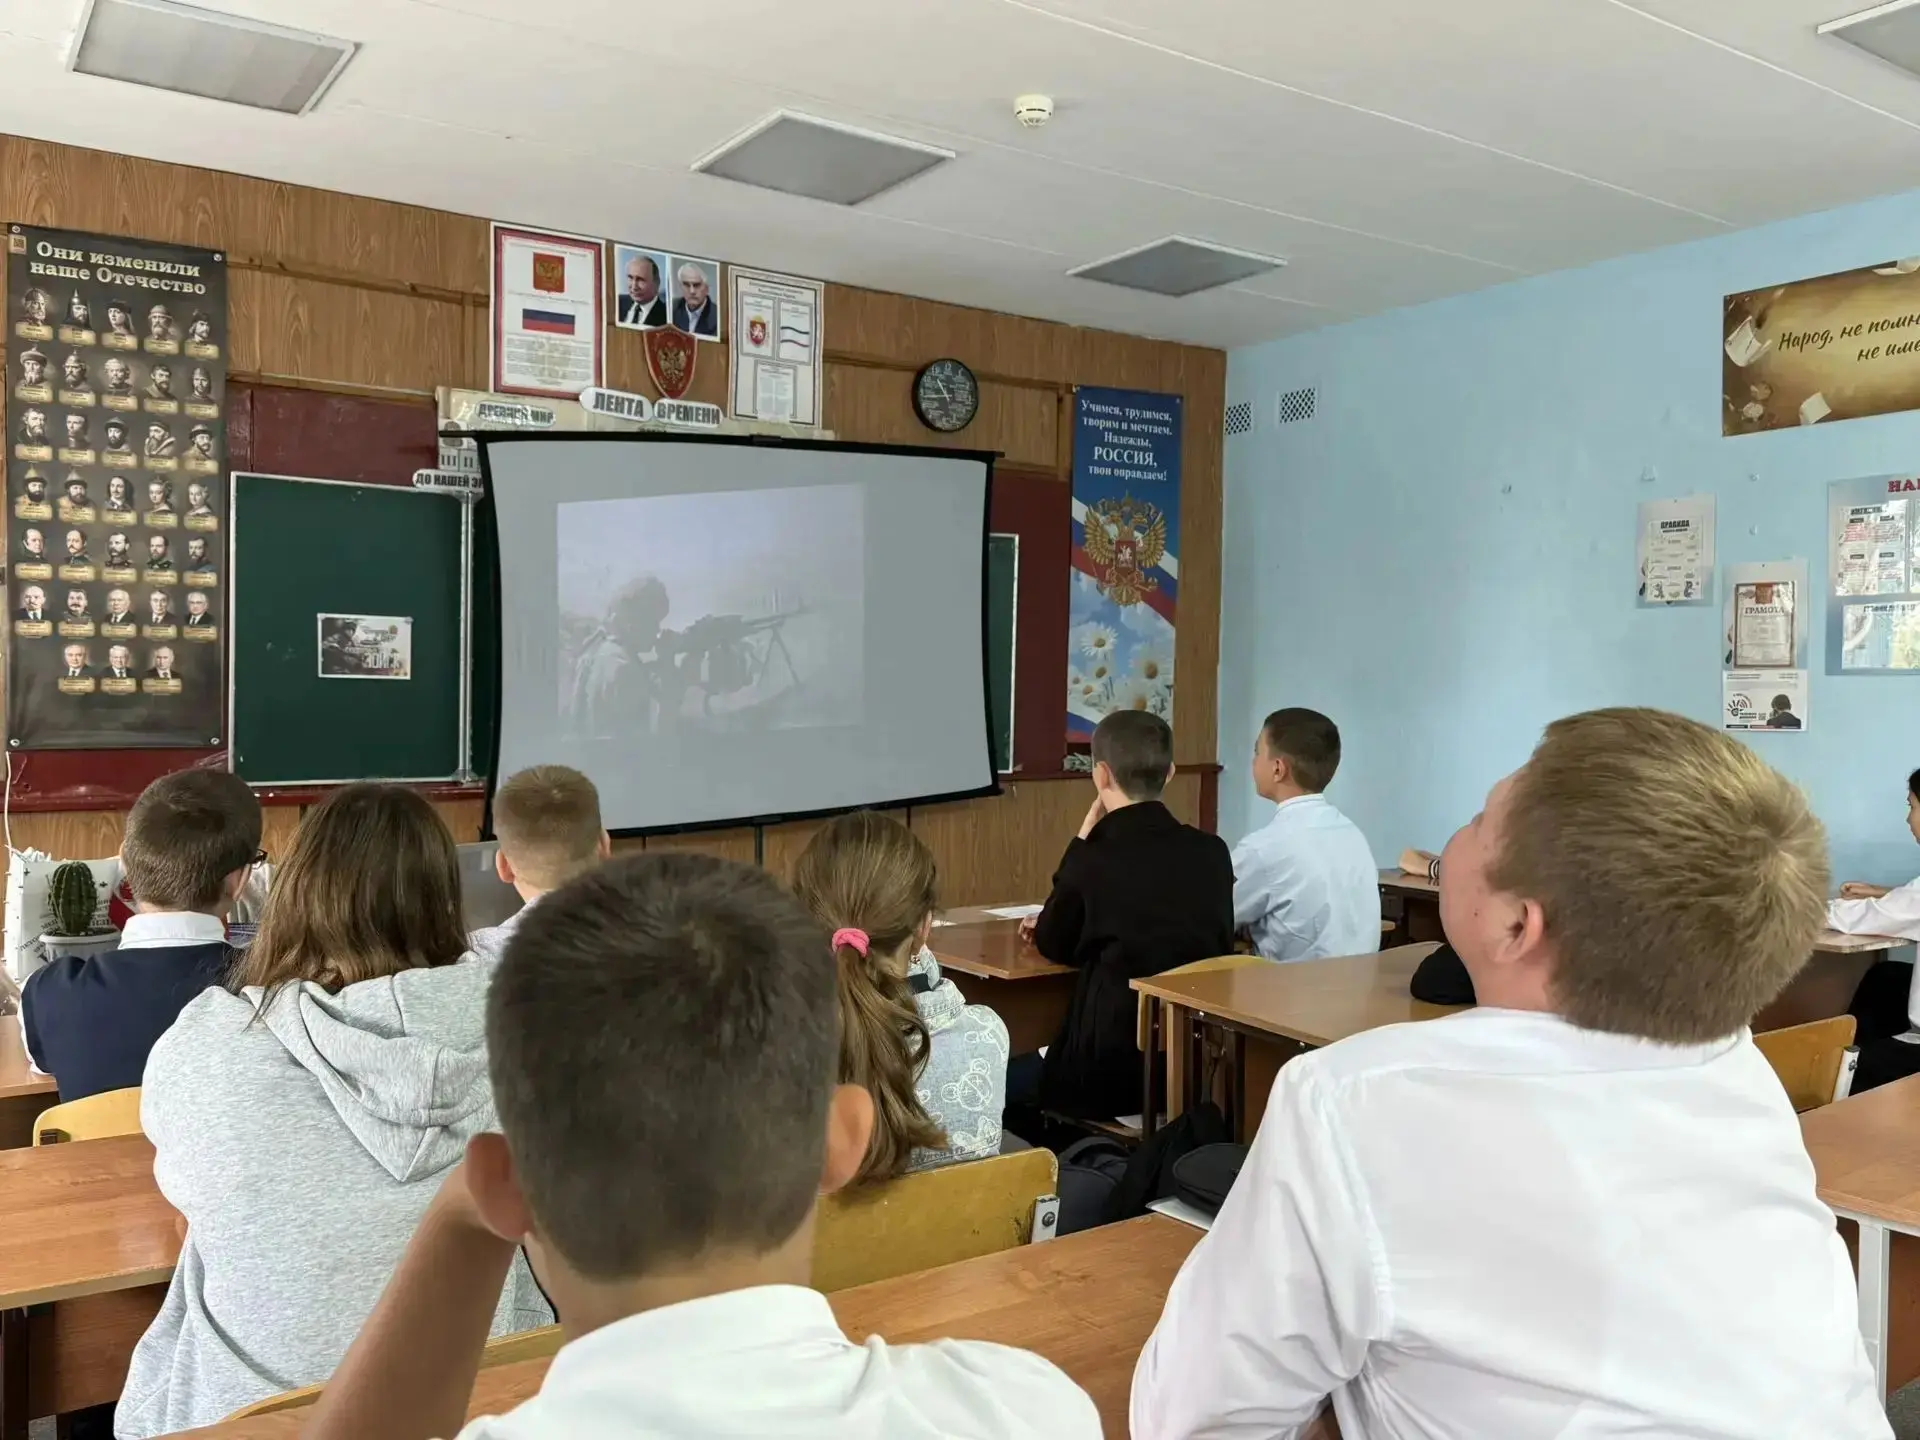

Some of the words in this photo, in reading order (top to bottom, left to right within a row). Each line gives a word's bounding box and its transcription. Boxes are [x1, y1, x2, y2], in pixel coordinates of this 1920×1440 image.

[36, 241, 83, 262] Они
[89, 251, 200, 277] изменили
[30, 261, 91, 280] наше
[96, 267, 206, 295] Отечество
[1778, 329, 1834, 353] Народ,
[1840, 323, 1863, 339] не
[1857, 346, 1880, 361] не
[592, 391, 644, 418] ЛЕНТА
[656, 402, 720, 425] ВРЕМЕНИ
[1081, 399, 1122, 416] Учимся,
[1125, 408, 1172, 422] трудимся,
[1082, 416, 1119, 430] творим
[1104, 431, 1152, 448] Надежды,
[1093, 446, 1158, 468] РОССИЯ,
[415, 473, 432, 486] ДО
[433, 474, 470, 488] НАШЕЙ
[1088, 465, 1111, 475] твои
[1113, 468, 1167, 480] оправдаем!
